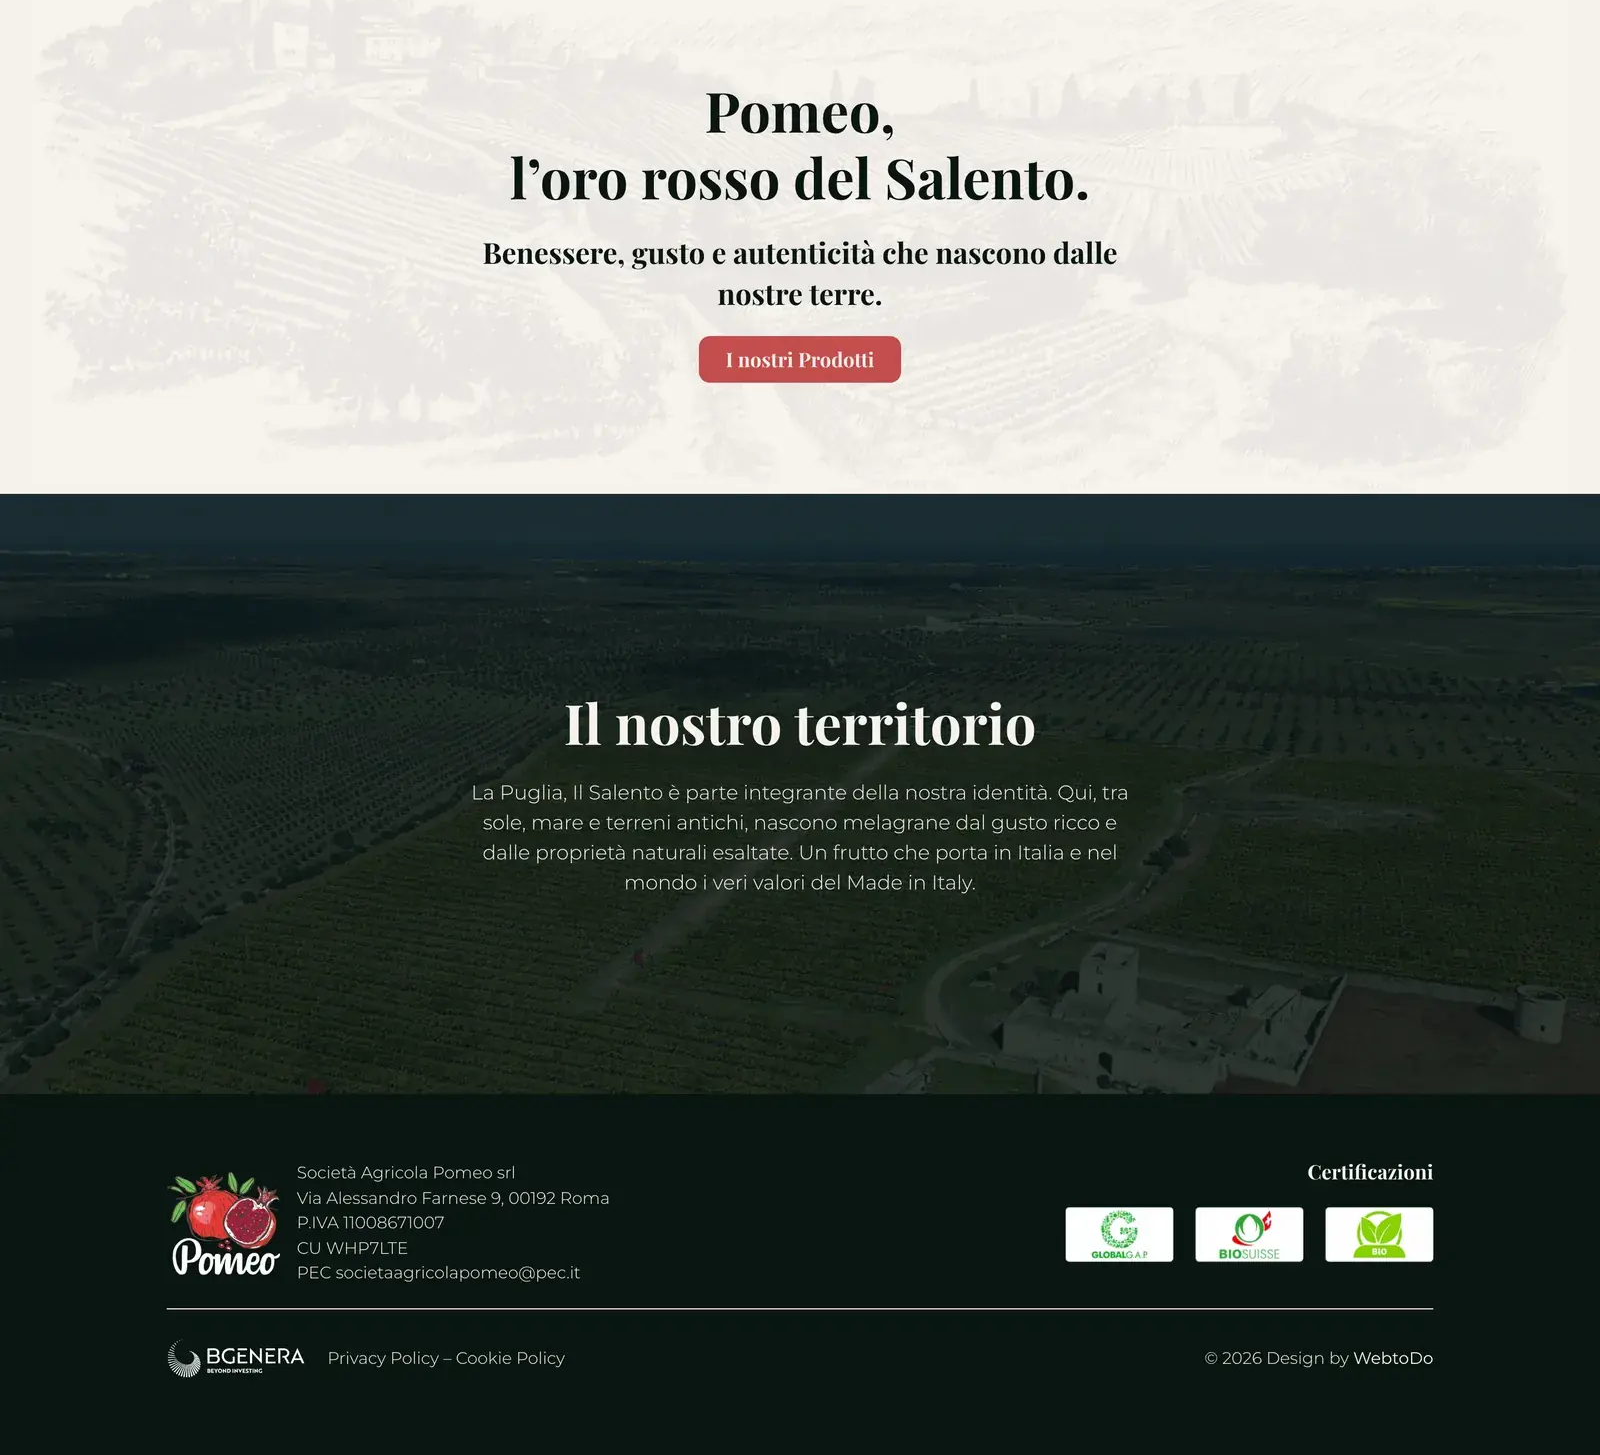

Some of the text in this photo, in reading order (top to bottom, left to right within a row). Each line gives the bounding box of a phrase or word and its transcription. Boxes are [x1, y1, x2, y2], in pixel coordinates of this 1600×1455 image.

[705, 92, 894, 141] Pomeo,
[510, 155, 1088, 201] l’oro rosso del Salento.
[482, 239, 1118, 271] Benessere, gusto e autenticità che nascono dalle
[717, 284, 882, 307] nostre terre.
[726, 350, 875, 369] I nostri Prodotti
[564, 700, 1035, 747] Il nostro territorio
[625, 873, 976, 895] mondo i veri valori del Made in Italy.
[297, 1165, 515, 1183] Società Agricola Pomeo srl
[1307, 1163, 1434, 1181] Certificazioni
[296, 1190, 610, 1207] Via Alessandro Farnese 9, 00192 Roma
[297, 1215, 445, 1230] P.IVA 11008671007
[172, 1238, 281, 1275] Pomeo
[296, 1241, 408, 1255] CU WHP7LTE
[1371, 1247, 1387, 1256] BIO
[297, 1265, 581, 1283] PEC societaagricolapomeo@pec.it
[206, 1347, 305, 1365] BGENERA
[328, 1350, 387, 1369] Privacy
[391, 1350, 440, 1369] Policy
[455, 1350, 512, 1365] Cookie
[517, 1350, 566, 1369] Policy
[1222, 1351, 1263, 1365] 2026
[1267, 1350, 1325, 1368] Design
[1330, 1350, 1350, 1368] by
[1353, 1351, 1434, 1365] WebtoDo
